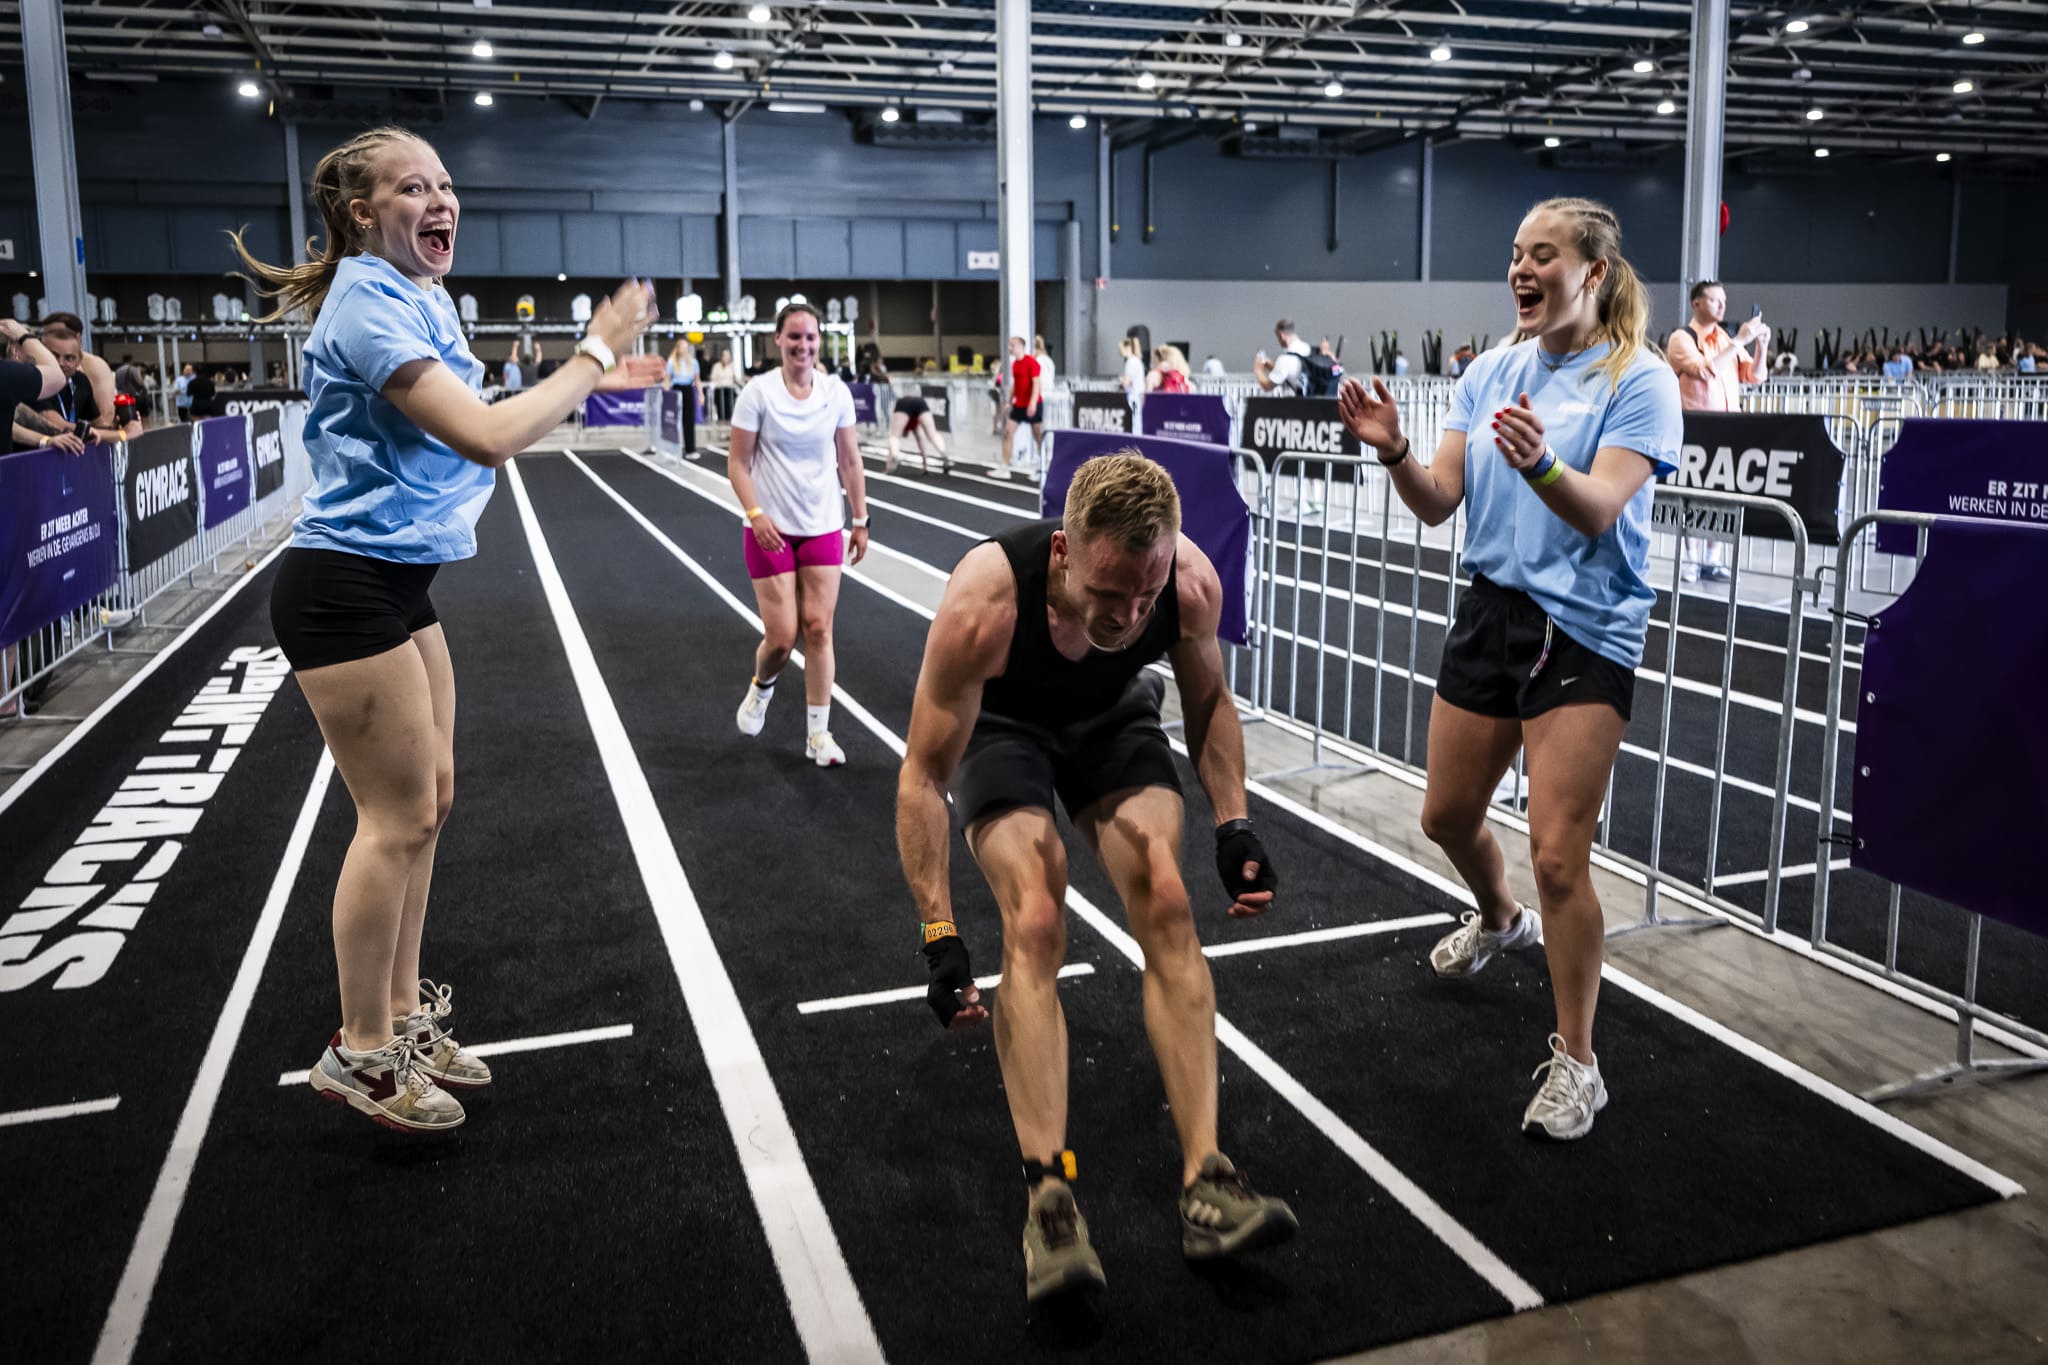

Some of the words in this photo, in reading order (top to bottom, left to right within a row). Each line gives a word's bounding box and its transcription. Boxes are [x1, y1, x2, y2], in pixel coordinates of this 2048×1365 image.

[1253, 417, 1345, 453] GYMRACE
[135, 457, 189, 522] GYMRACE
[1987, 480, 2007, 496] ER
[2012, 482, 2039, 499] ZIT
[1948, 495, 2007, 516] WERKEN
[2011, 501, 2026, 517] IN
[56, 514, 71, 534] MEER
[53, 538, 62, 557] DE
